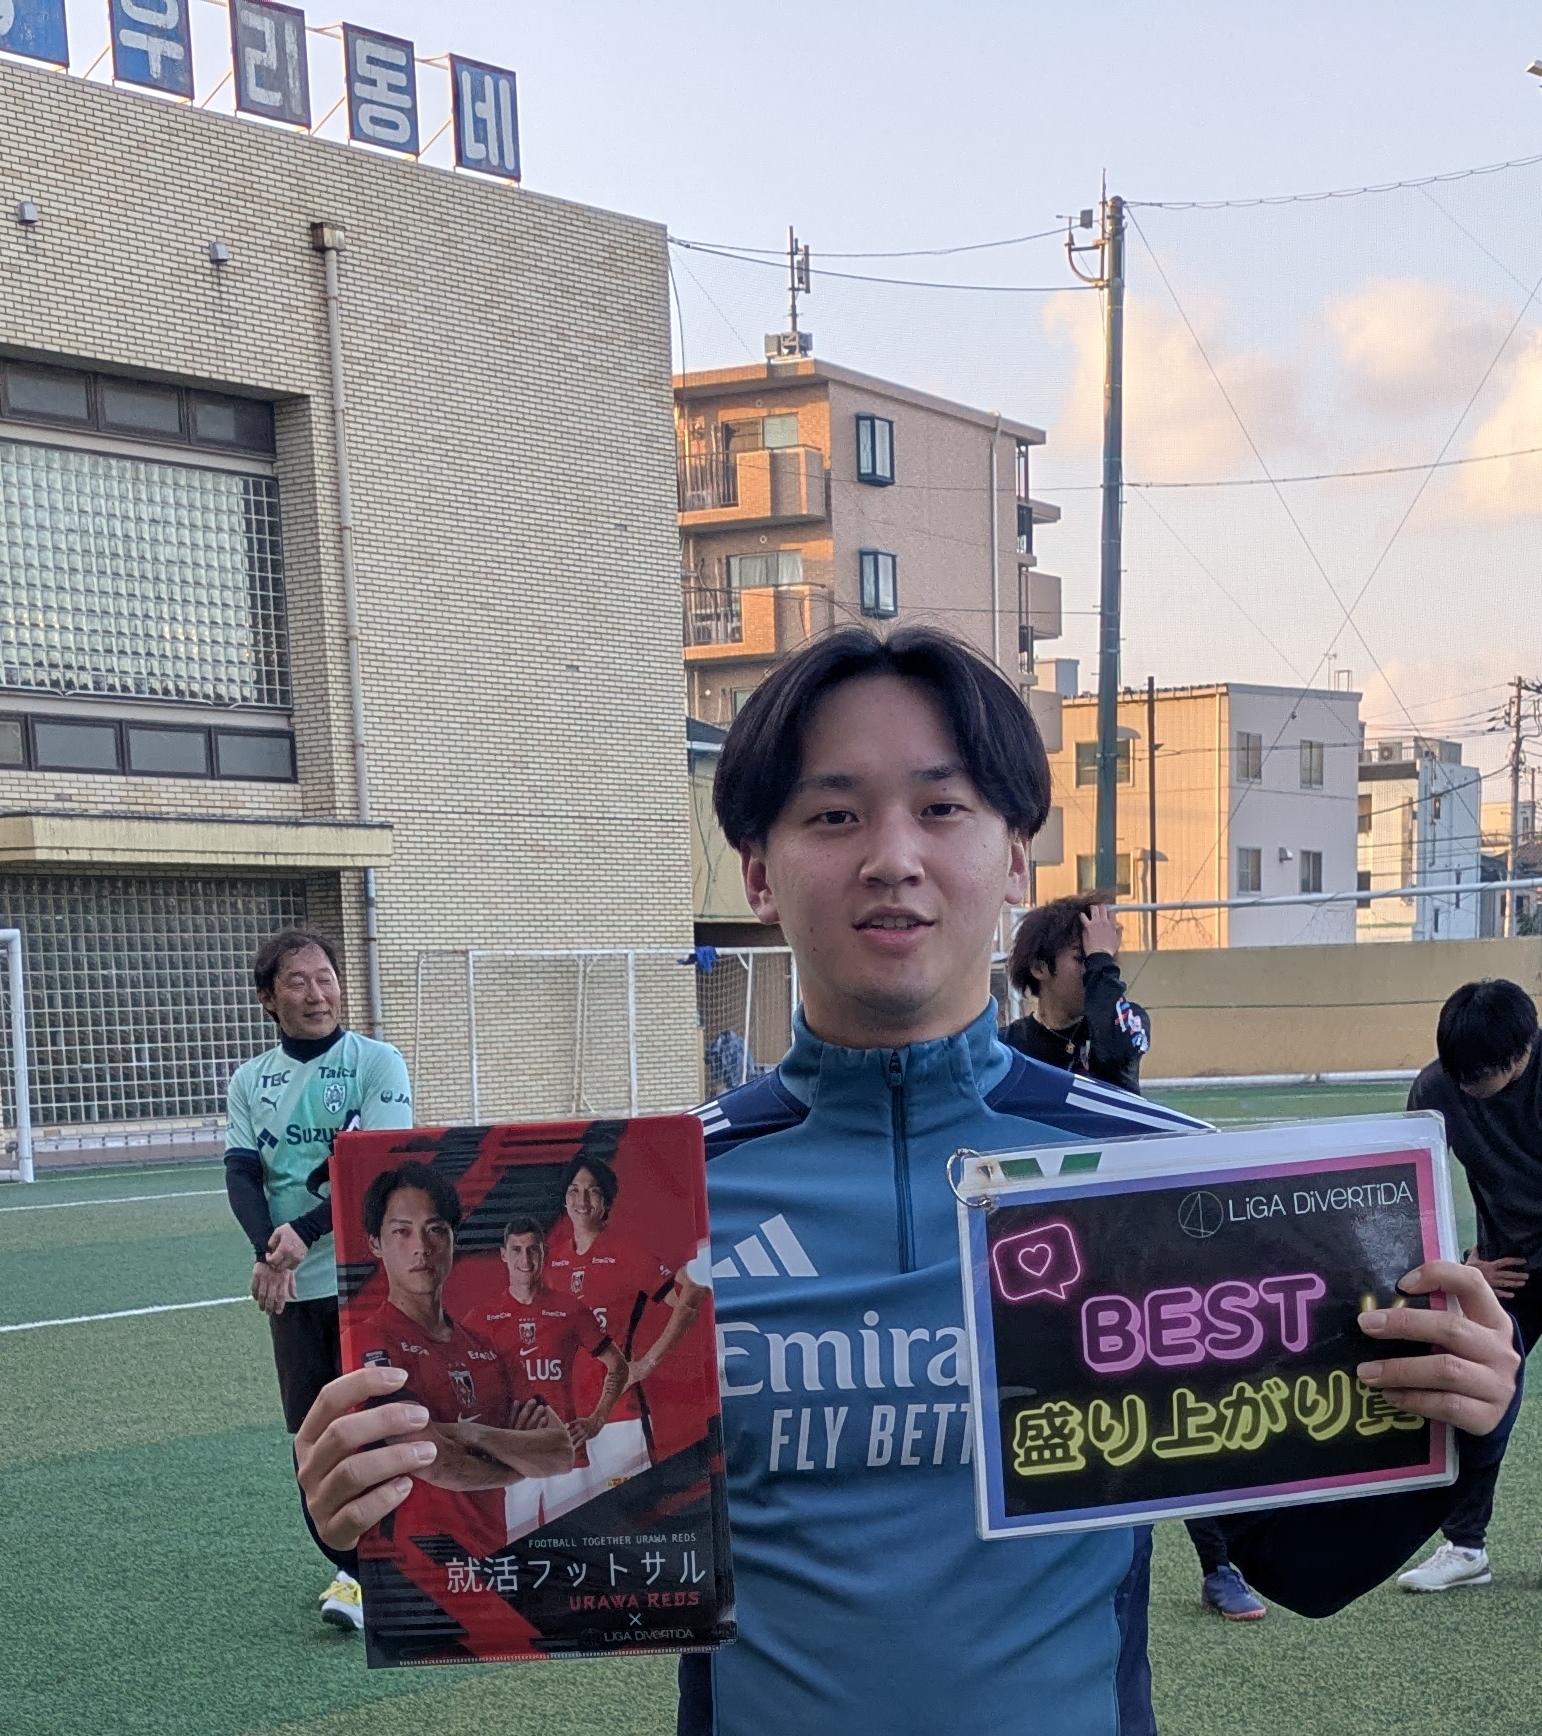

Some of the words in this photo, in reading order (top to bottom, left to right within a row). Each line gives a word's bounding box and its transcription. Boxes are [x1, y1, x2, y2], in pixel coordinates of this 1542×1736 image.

[1080, 1272, 1327, 1373] BEST
[769, 1406, 849, 1472] FLY
[528, 1537, 577, 1549] FOOTBALL
[582, 1535, 632, 1547] TOGETHER
[636, 1534, 667, 1544] URAWA
[671, 1532, 697, 1543] REDS
[445, 1550, 707, 1593] 就活フットサル
[569, 1592, 640, 1611] URAWA
[647, 1590, 700, 1609] REDS
